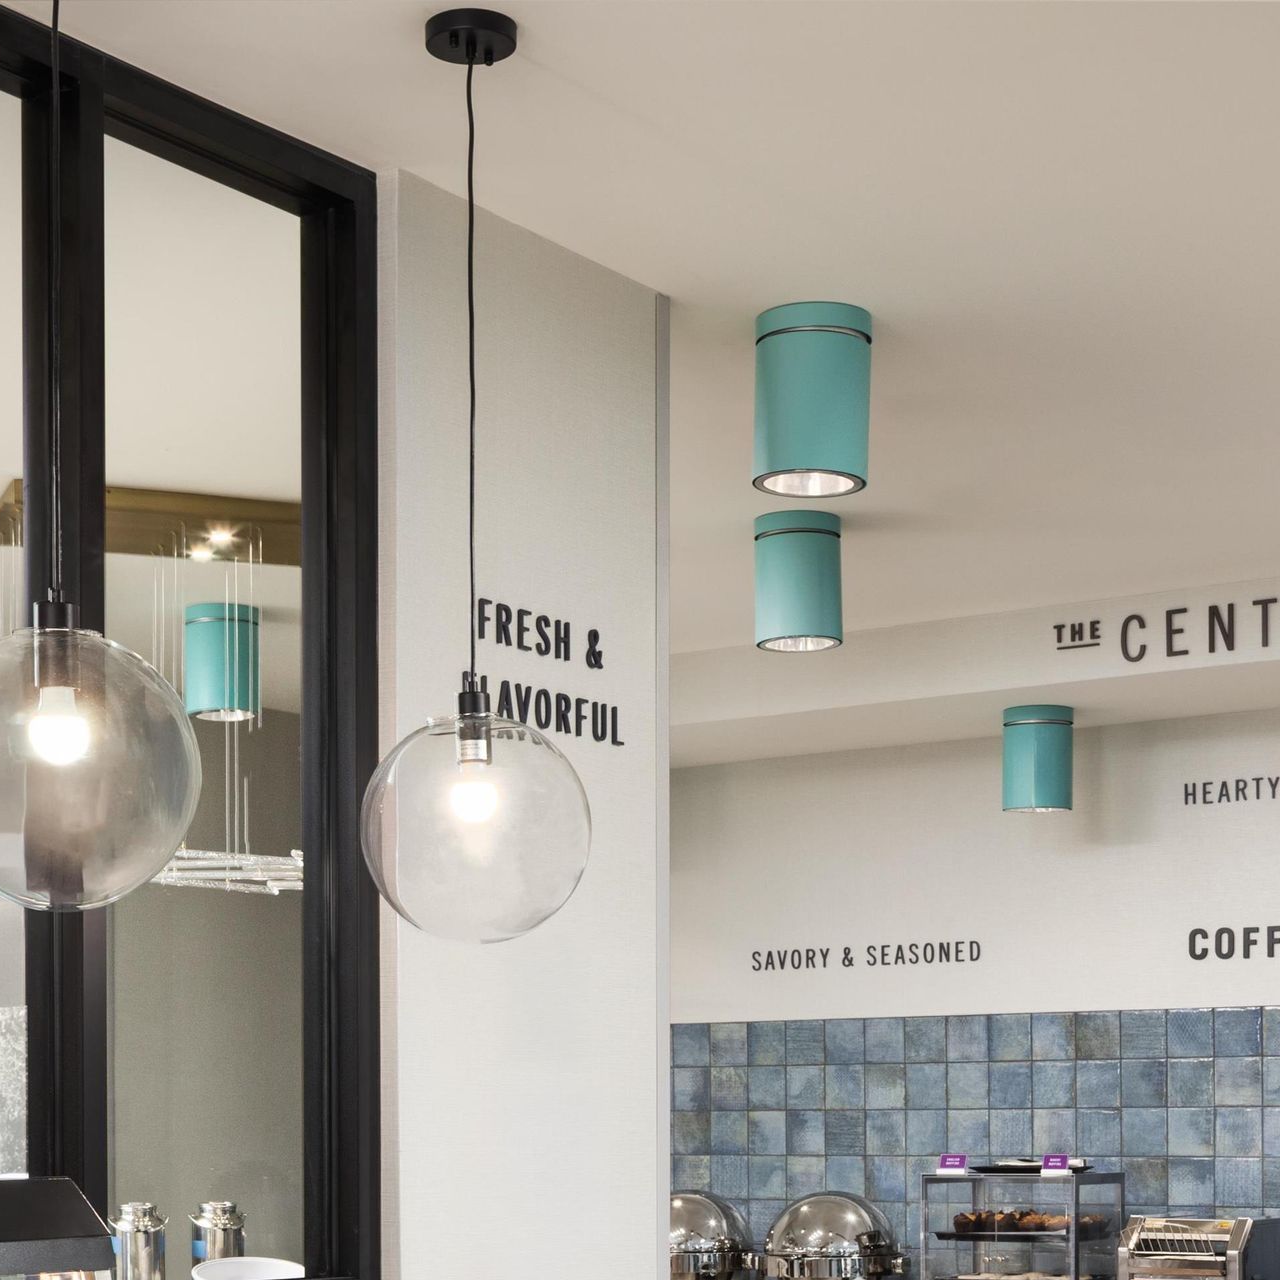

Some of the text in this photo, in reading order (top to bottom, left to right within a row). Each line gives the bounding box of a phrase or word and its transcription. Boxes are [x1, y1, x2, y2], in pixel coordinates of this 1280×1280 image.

[477, 597, 604, 669] FRESH &
[1053, 620, 1101, 644] THE
[1184, 777, 1280, 805] HEARTY
[751, 940, 981, 972] SAVORY & SEASONED
